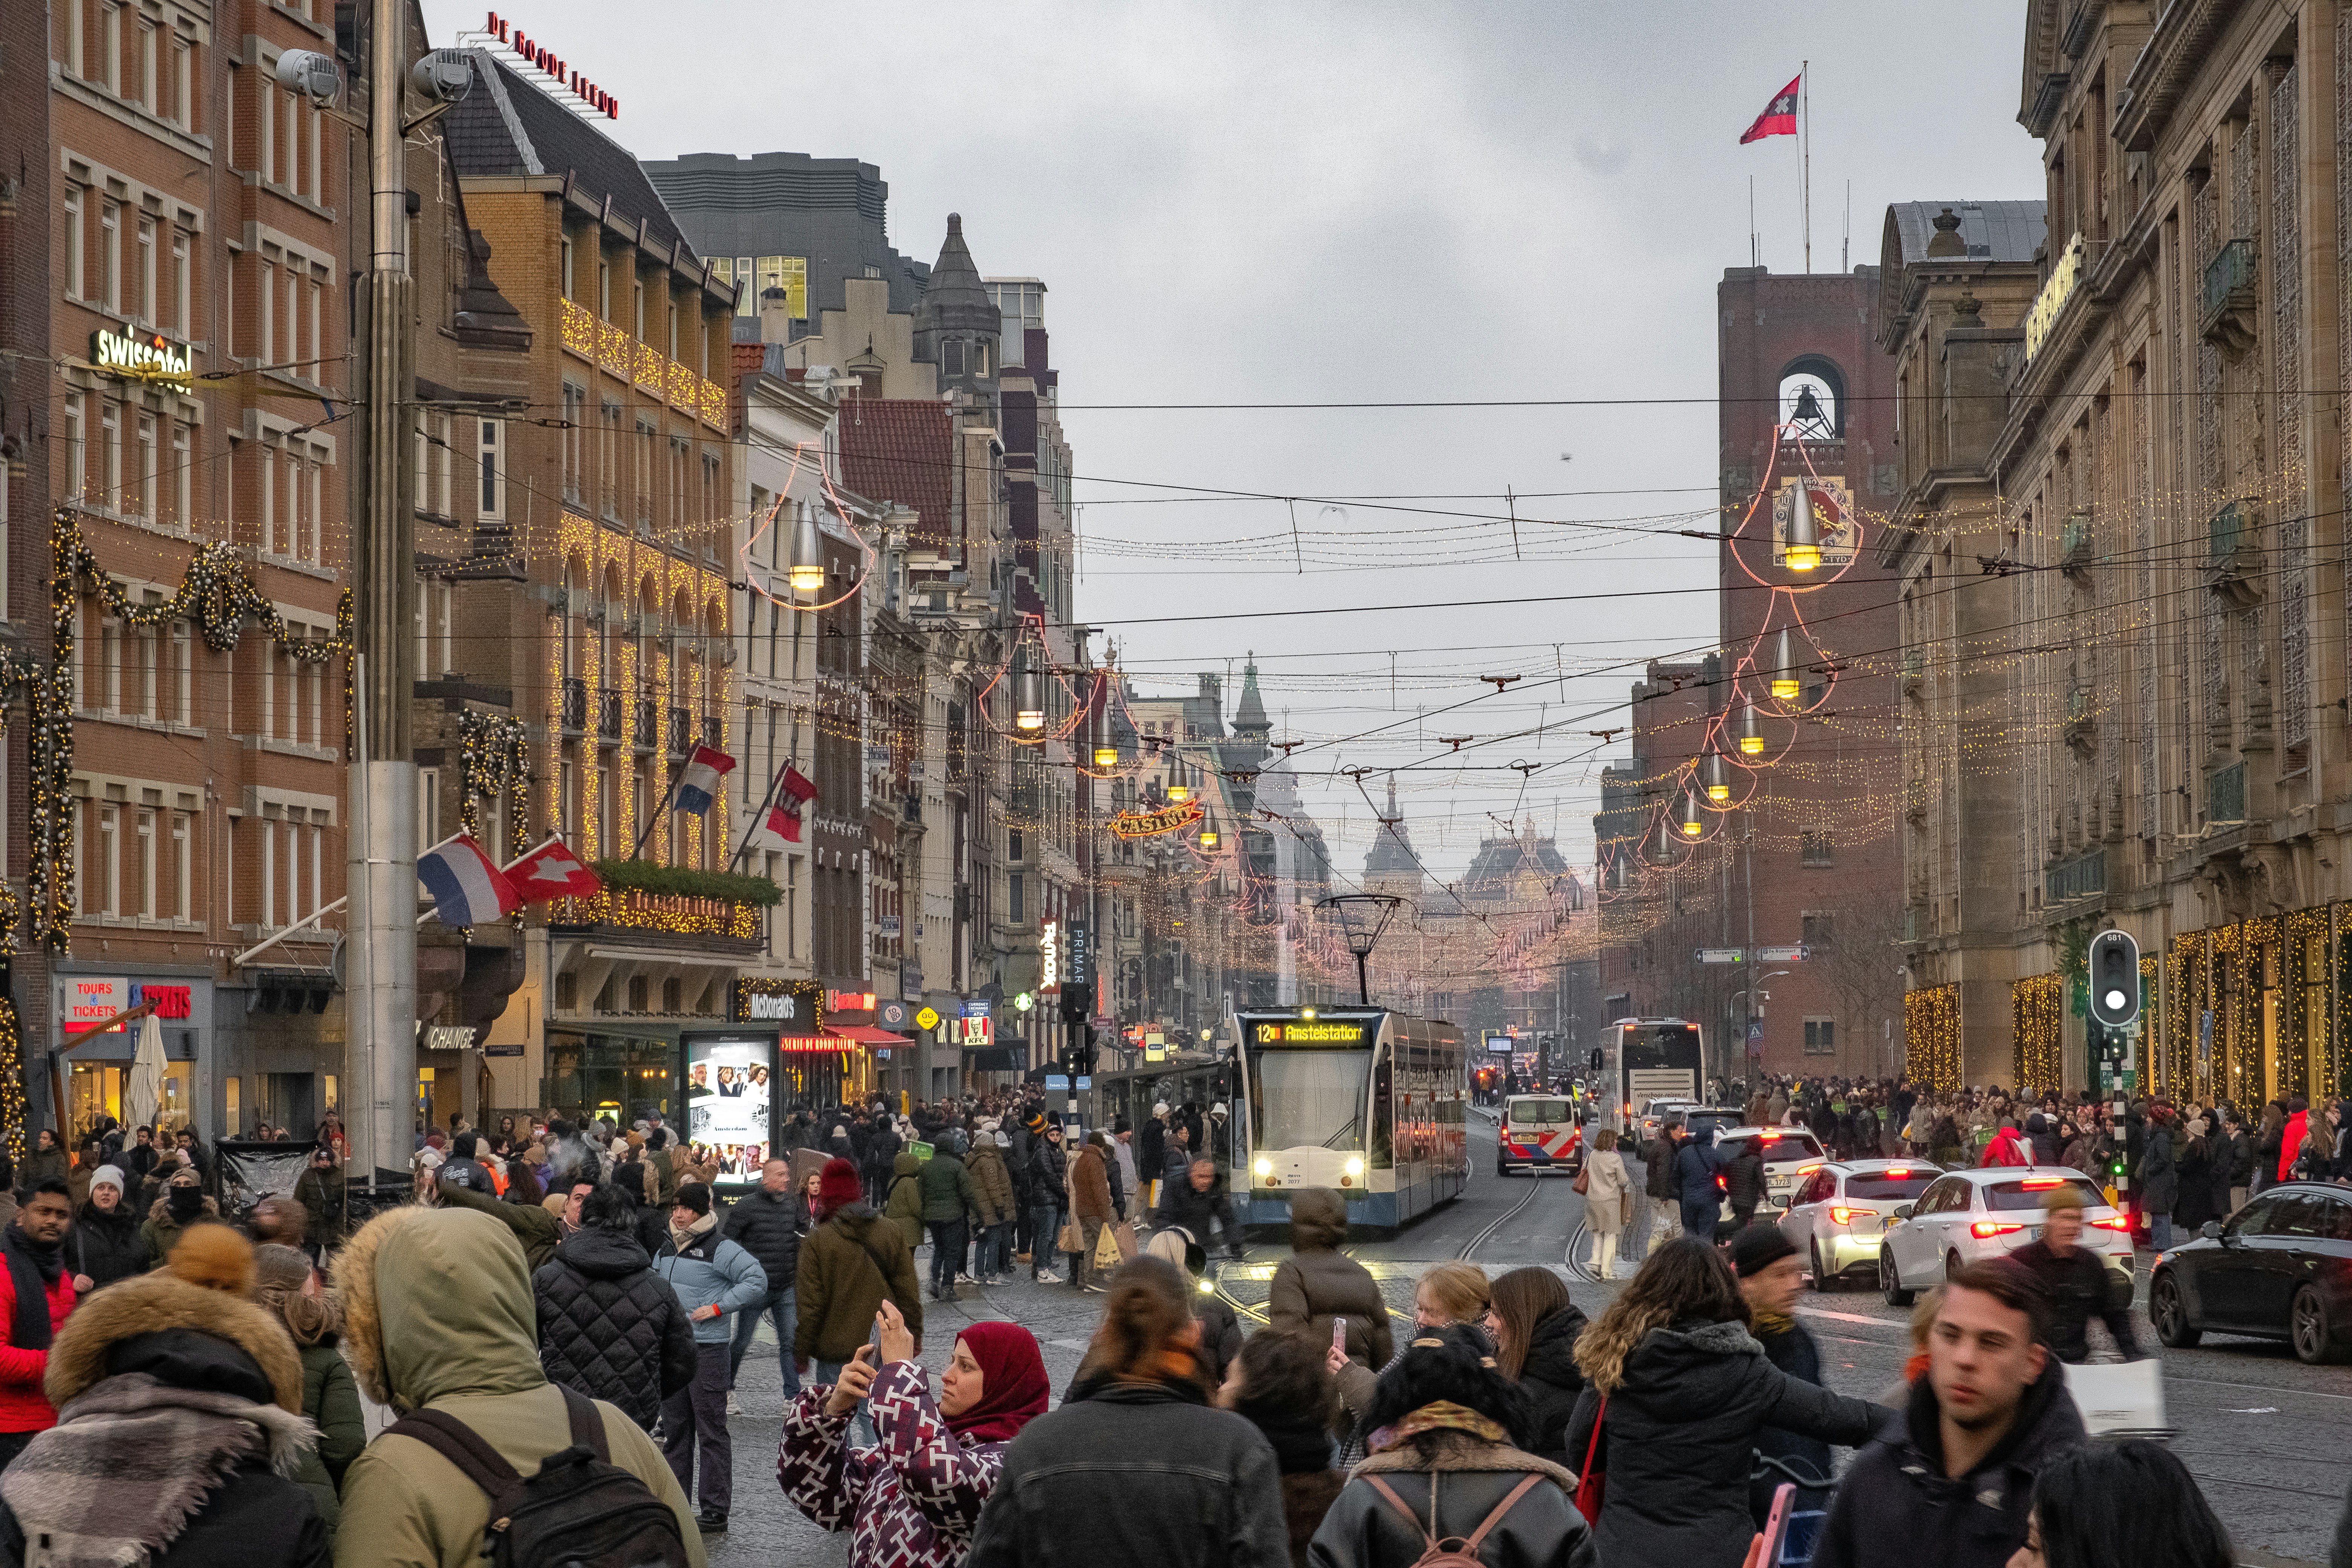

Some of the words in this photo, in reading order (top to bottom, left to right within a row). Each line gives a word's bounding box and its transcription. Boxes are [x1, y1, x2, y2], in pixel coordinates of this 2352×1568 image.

[487, 11, 509, 44] DE
[513, 30, 567, 84] ROODE
[1117, 806, 1192, 833] CASINO
[1074, 930, 1084, 983] PRIMAR
[77, 983, 112, 994] TOURS
[73, 1006, 116, 1017] TICKETS
[752, 993, 794, 1018] McDonald's
[430, 1027, 477, 1050] CHANGE
[1256, 1024, 1271, 1043] 12
[1285, 1025, 1361, 1040] Amstelstation
